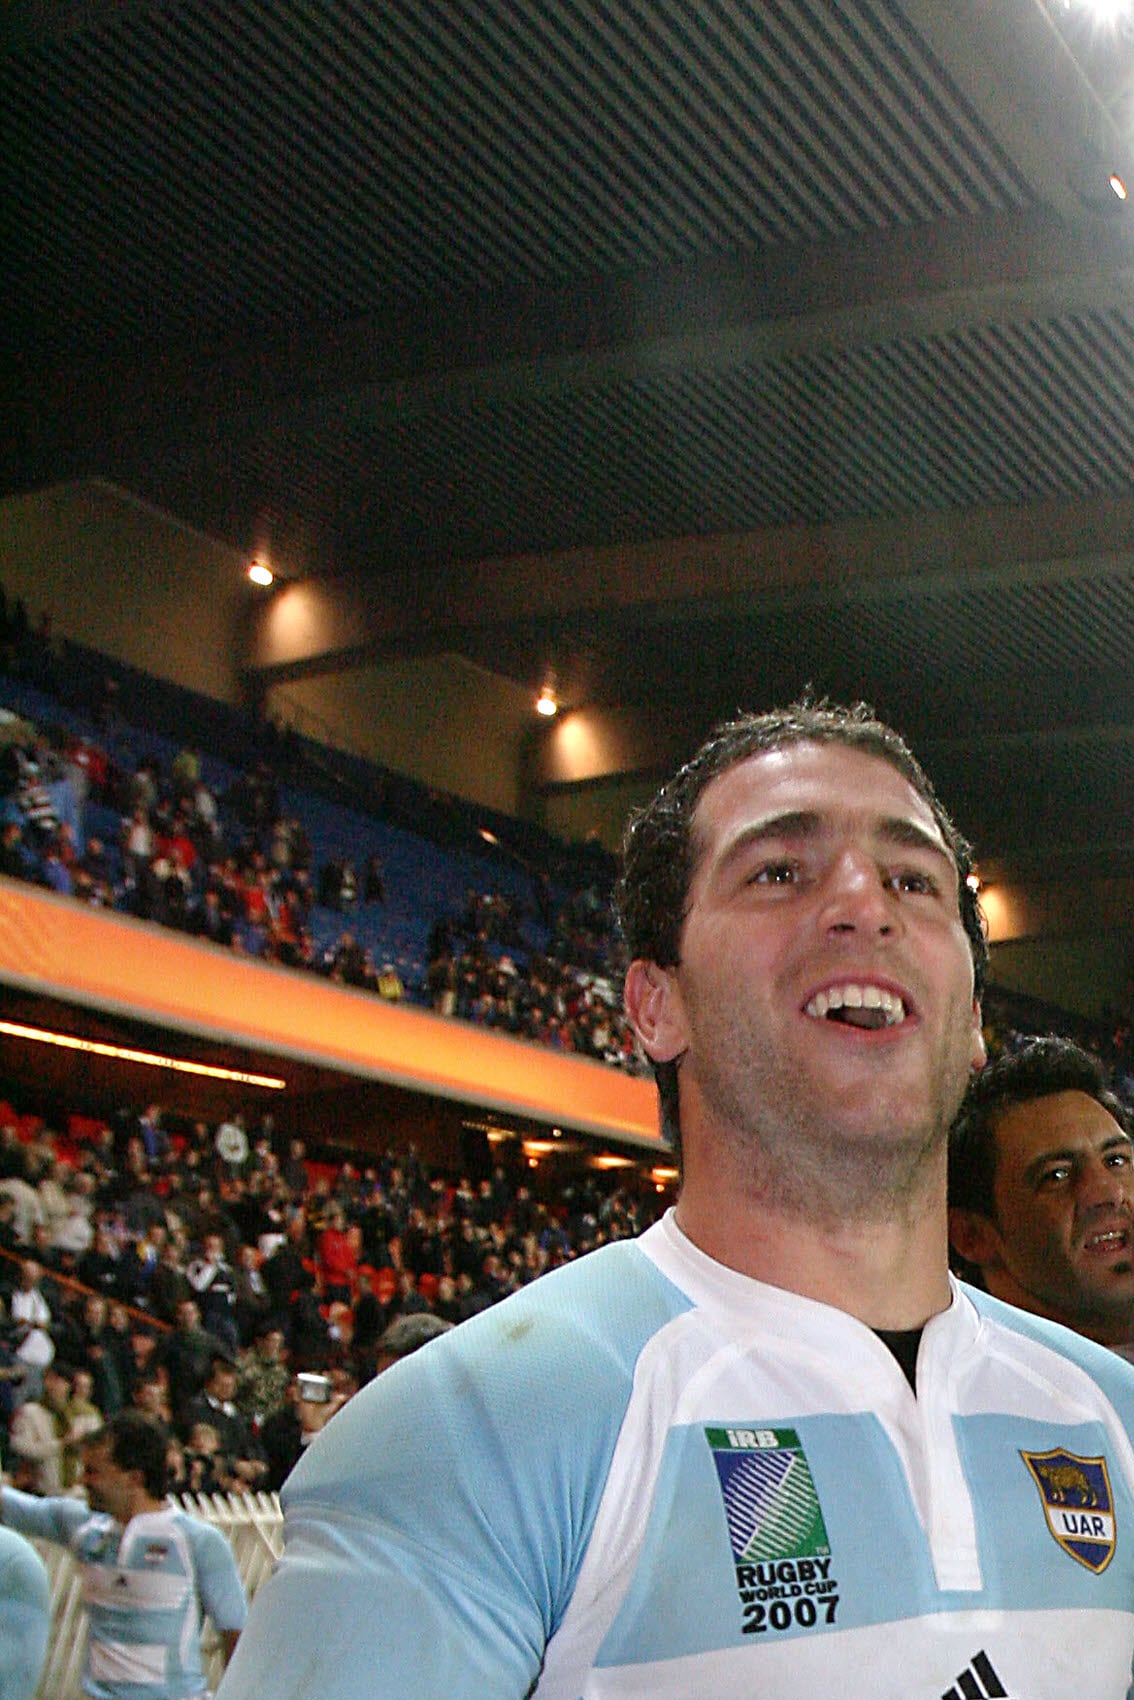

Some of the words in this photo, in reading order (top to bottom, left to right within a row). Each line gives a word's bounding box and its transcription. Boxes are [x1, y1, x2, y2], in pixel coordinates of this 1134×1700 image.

[1063, 1513, 1107, 1538] UAR
[736, 1558, 832, 1590] RUGBY
[739, 1584, 802, 1605] WORLD
[804, 1579, 839, 1597] CUP
[741, 1594, 840, 1635] 2007
